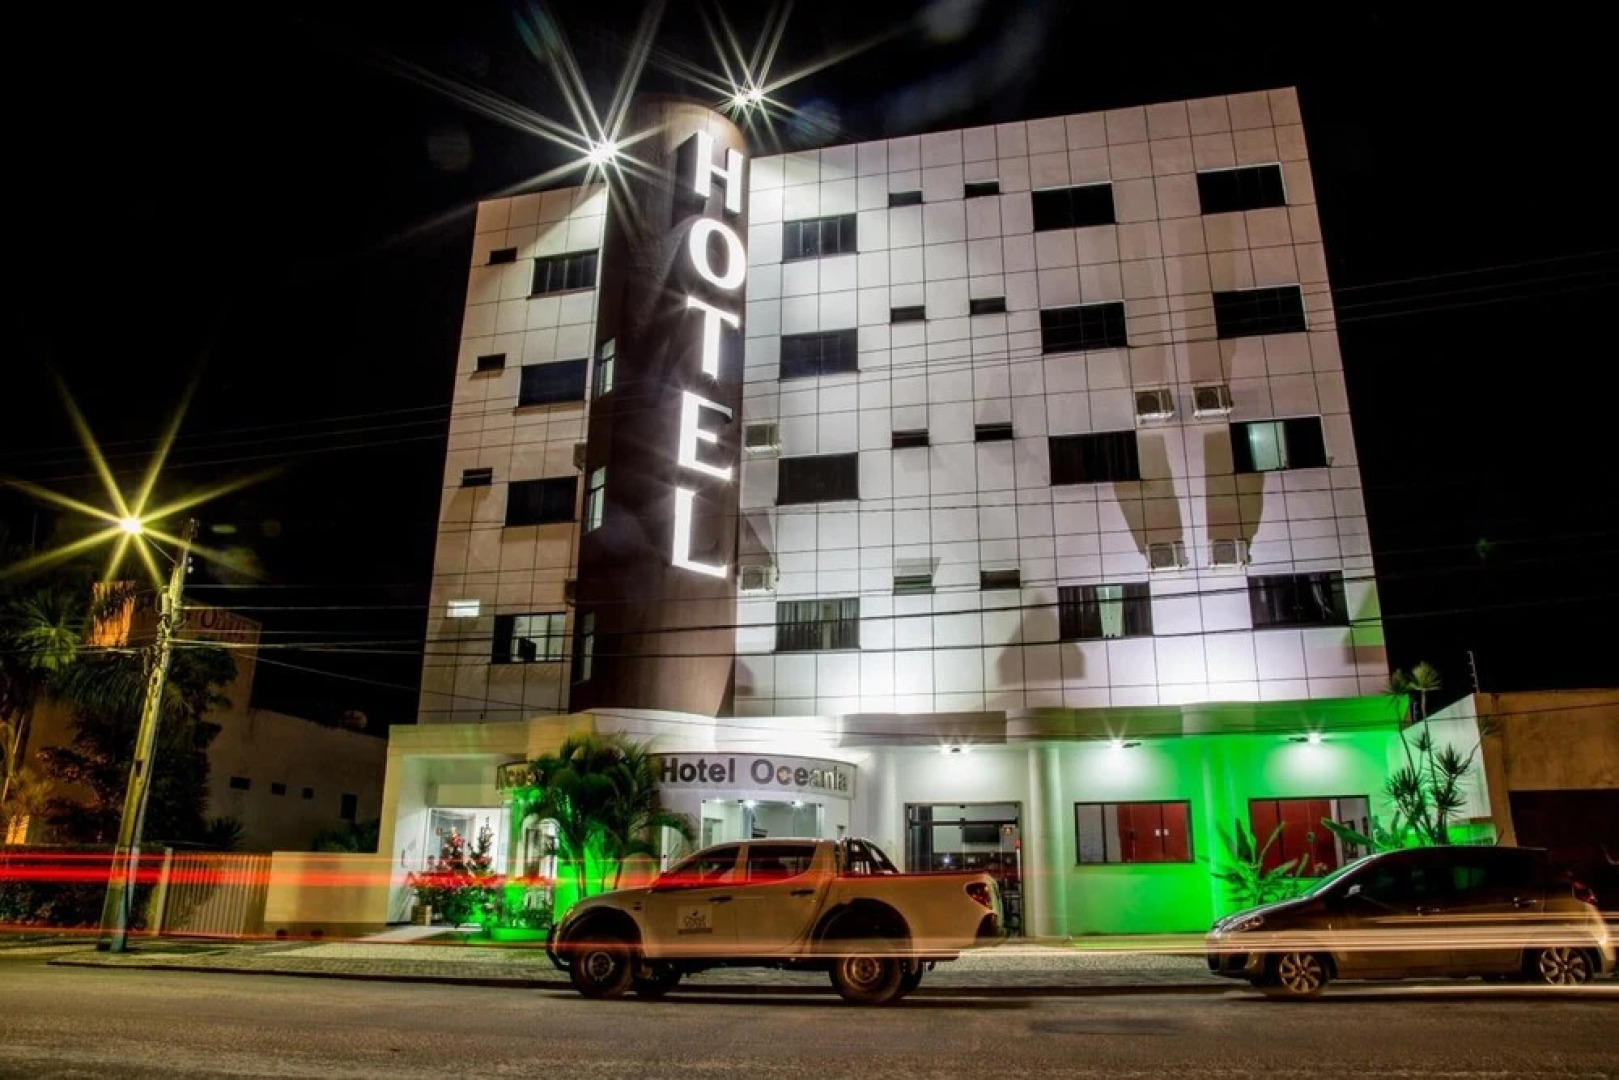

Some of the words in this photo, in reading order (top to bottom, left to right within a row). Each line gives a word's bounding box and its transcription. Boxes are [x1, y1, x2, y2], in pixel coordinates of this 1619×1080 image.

[671, 129, 746, 578] HOTEL
[660, 757, 735, 782] Hotel
[751, 759, 848, 791] Oceania
